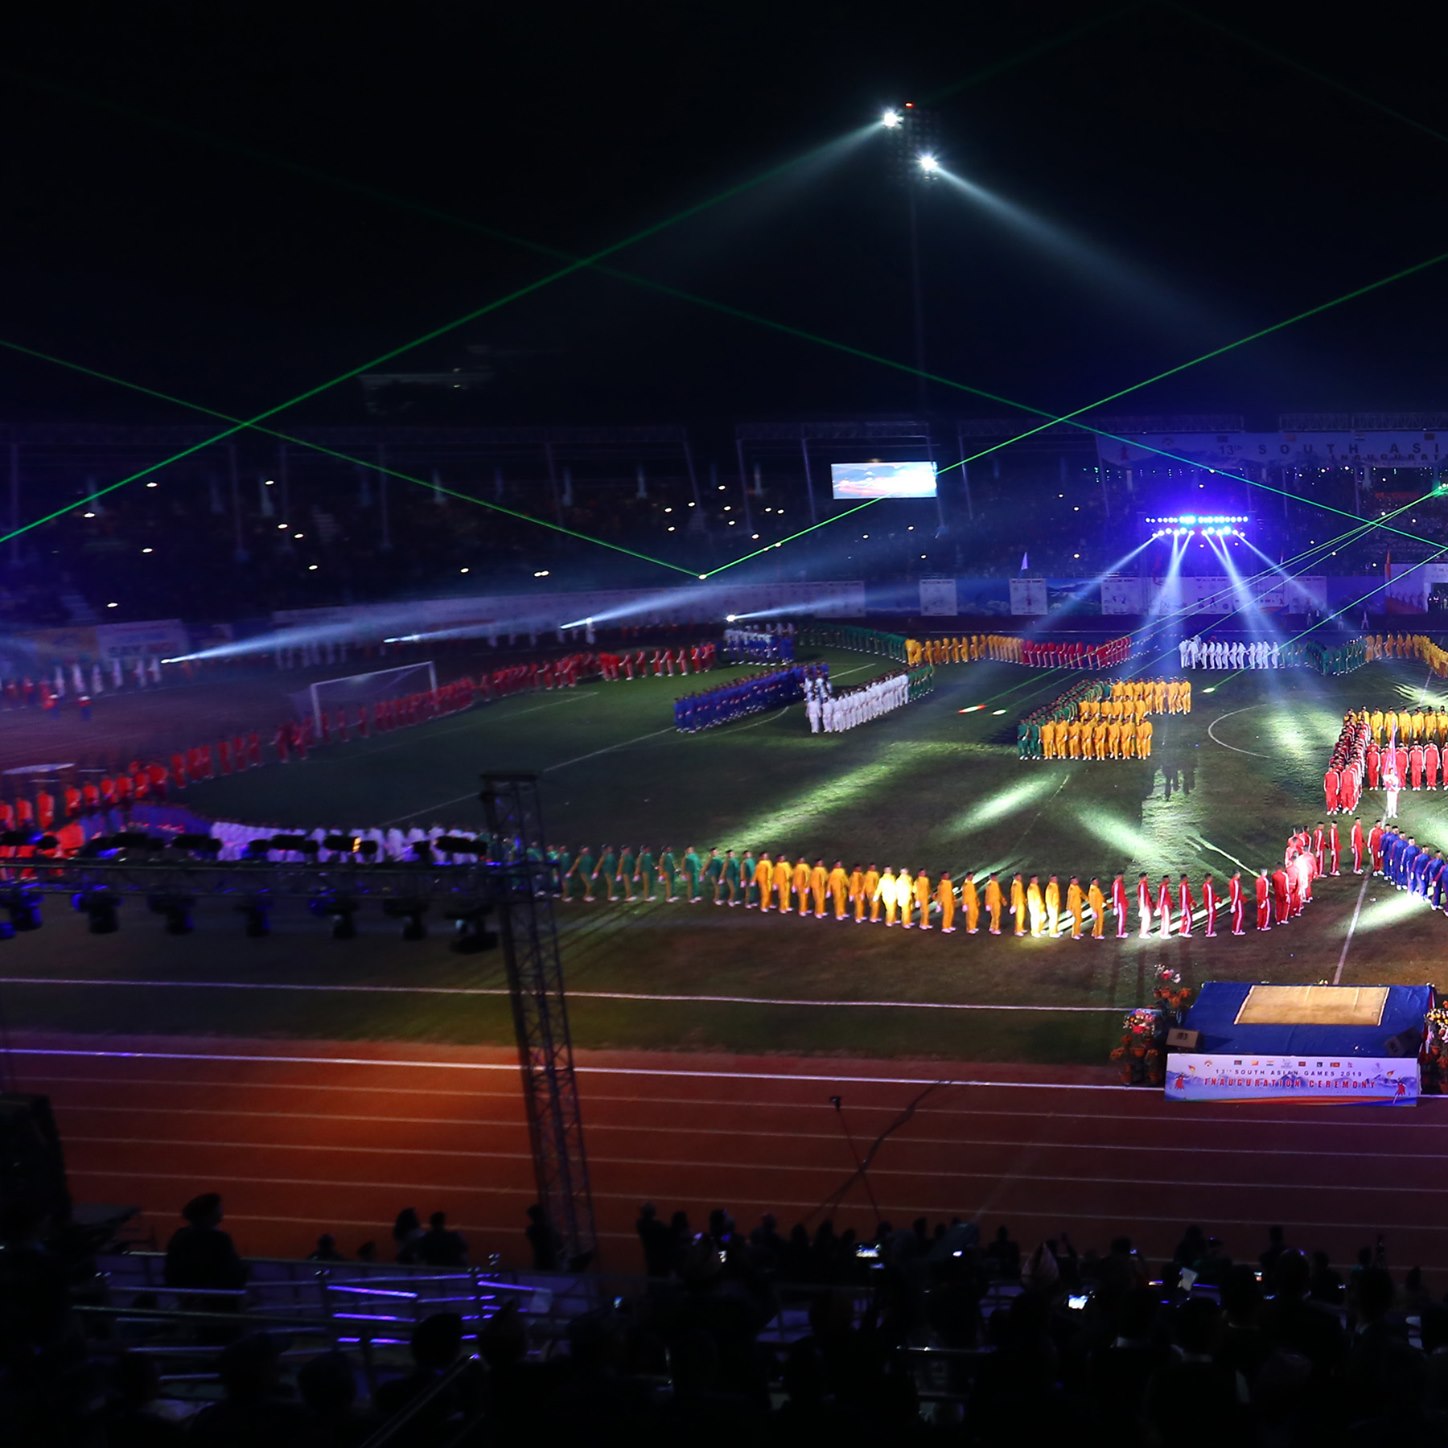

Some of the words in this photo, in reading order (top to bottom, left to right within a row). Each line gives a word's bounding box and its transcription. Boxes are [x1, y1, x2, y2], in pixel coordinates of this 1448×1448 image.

[1258, 443, 1359, 455] SOUTH
[1204, 1078, 1300, 1088] INAUGURATION
[1309, 1080, 1375, 1089] CEREMONY
